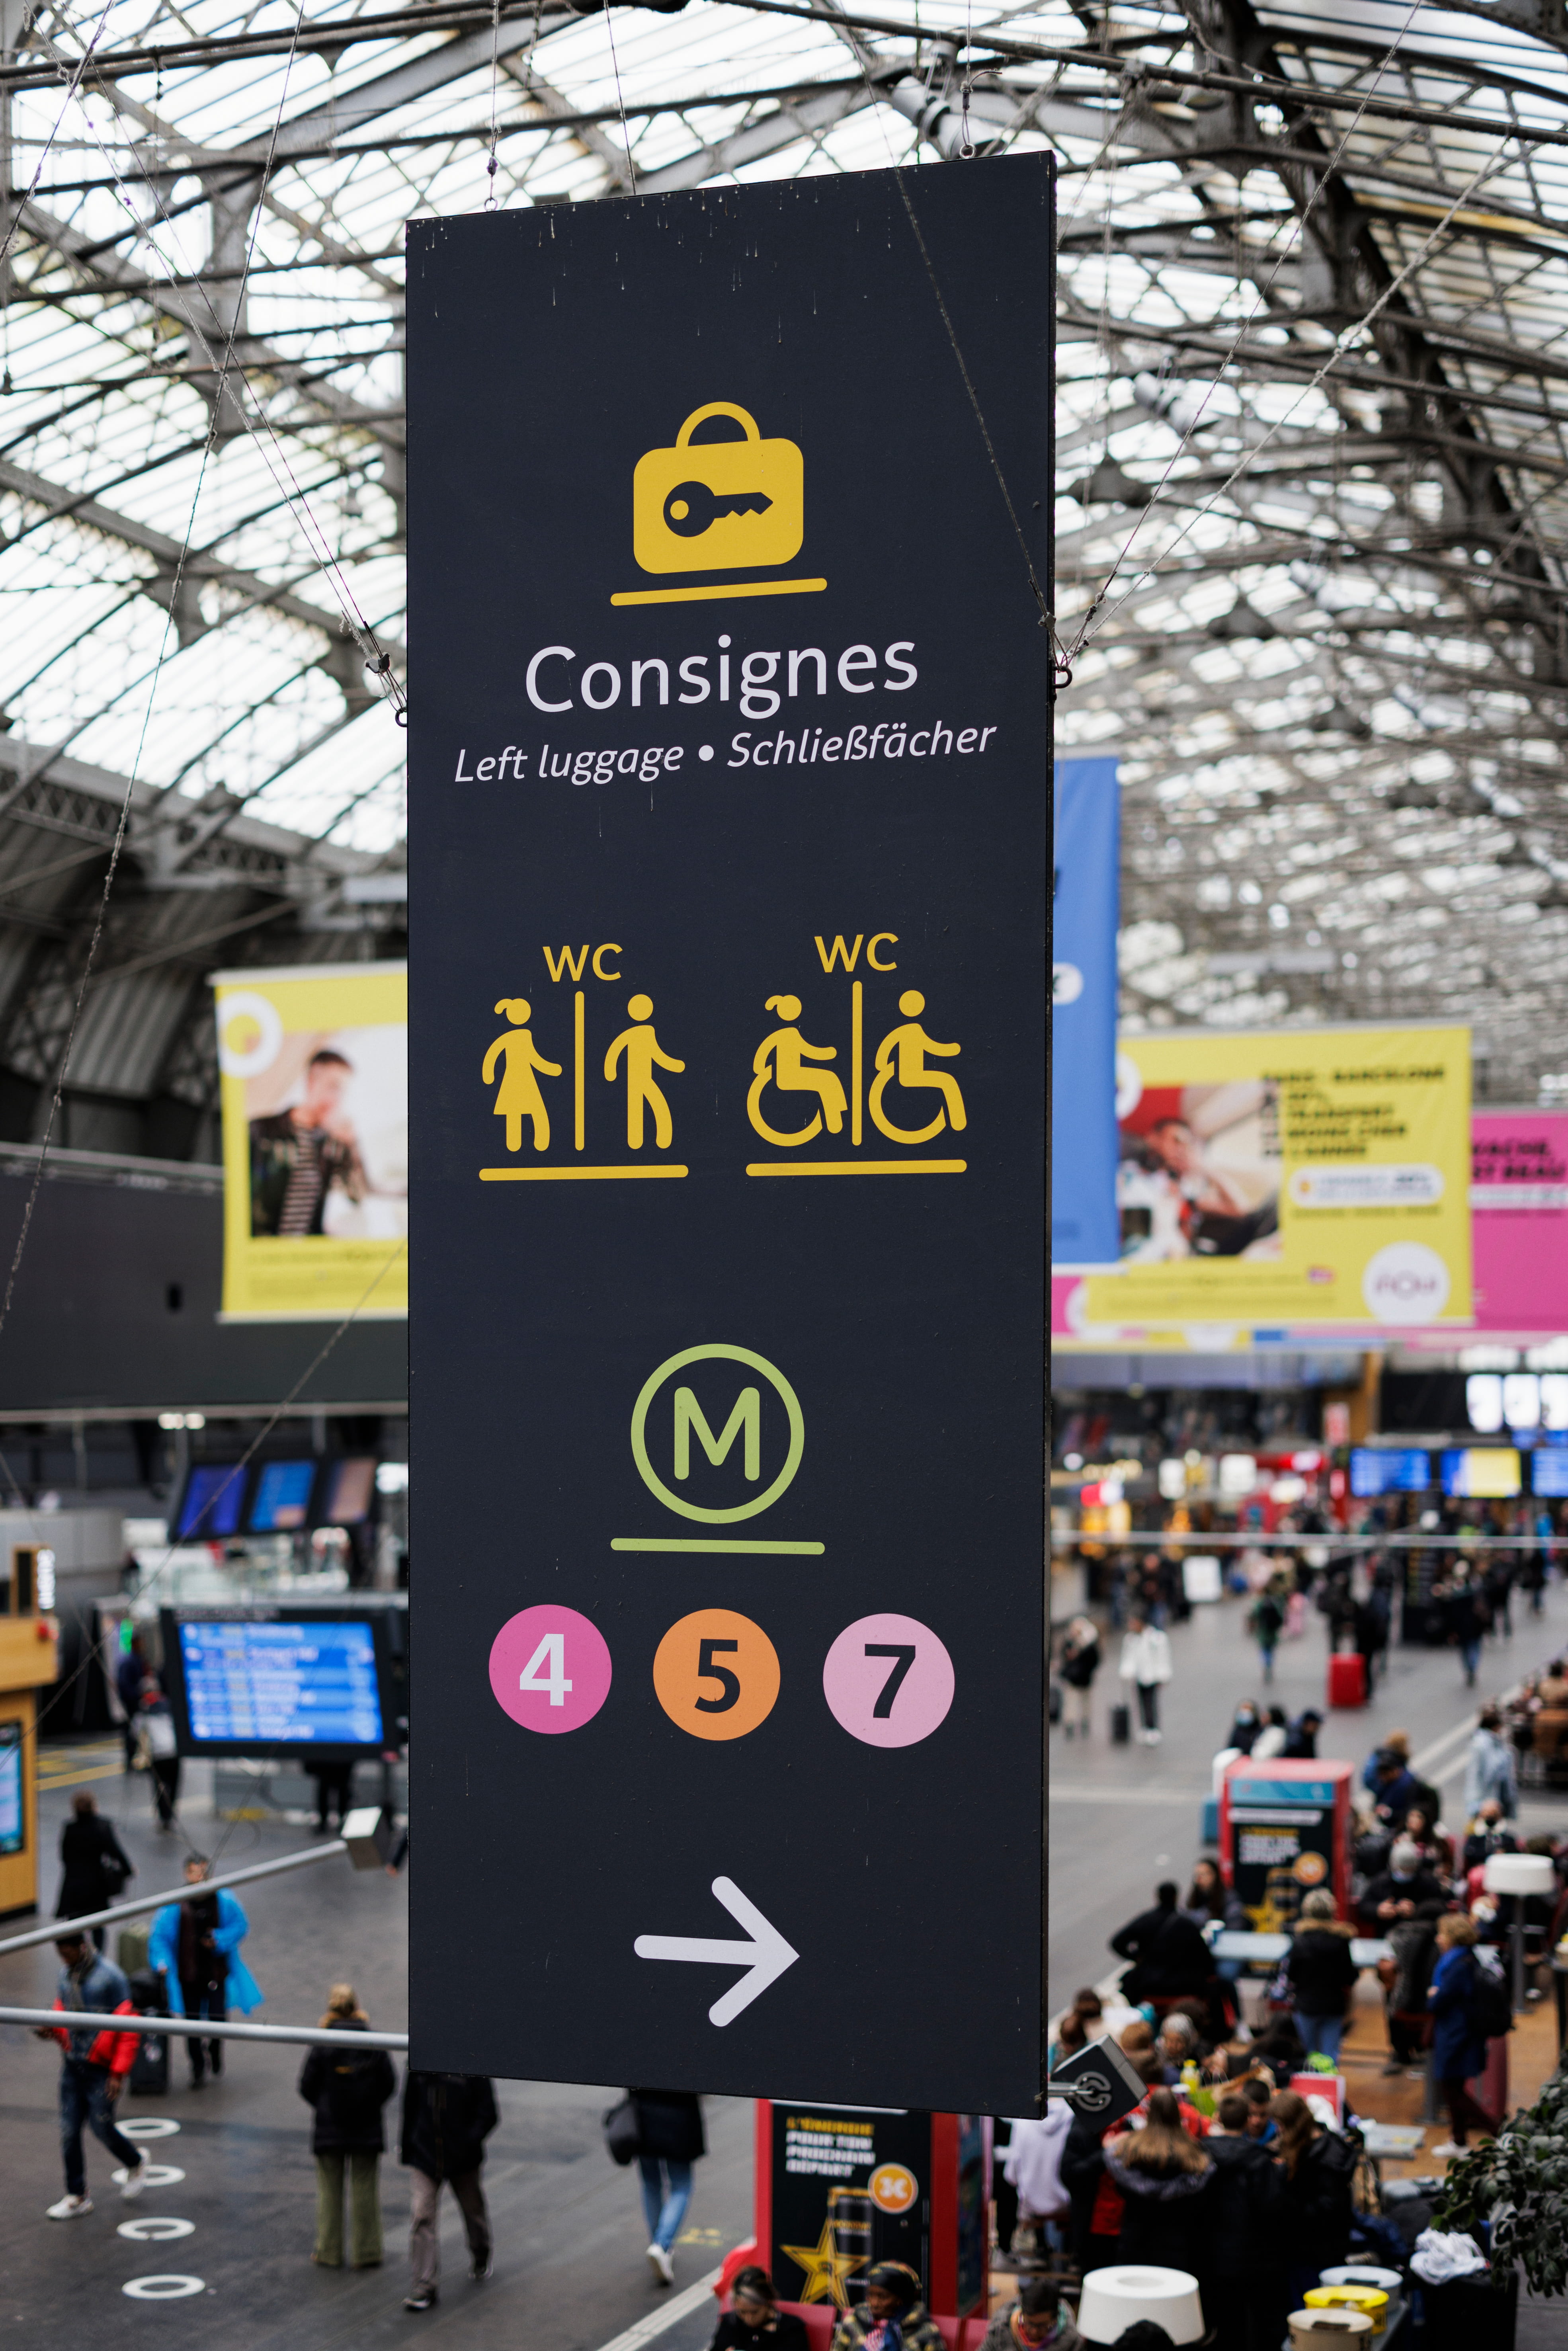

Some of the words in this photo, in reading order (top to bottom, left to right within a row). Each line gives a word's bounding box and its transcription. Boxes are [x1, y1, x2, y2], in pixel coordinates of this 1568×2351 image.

[526, 634, 918, 719] Consignes
[455, 746, 528, 782] Left
[539, 744, 684, 785] luggage
[727, 720, 997, 767] Schließfächer
[542, 943, 623, 982] WC
[814, 932, 899, 973] WC
[674, 1387, 760, 1481] M
[519, 1633, 572, 1706] 4
[694, 1638, 740, 1713] 5
[865, 1644, 916, 1718] 7
